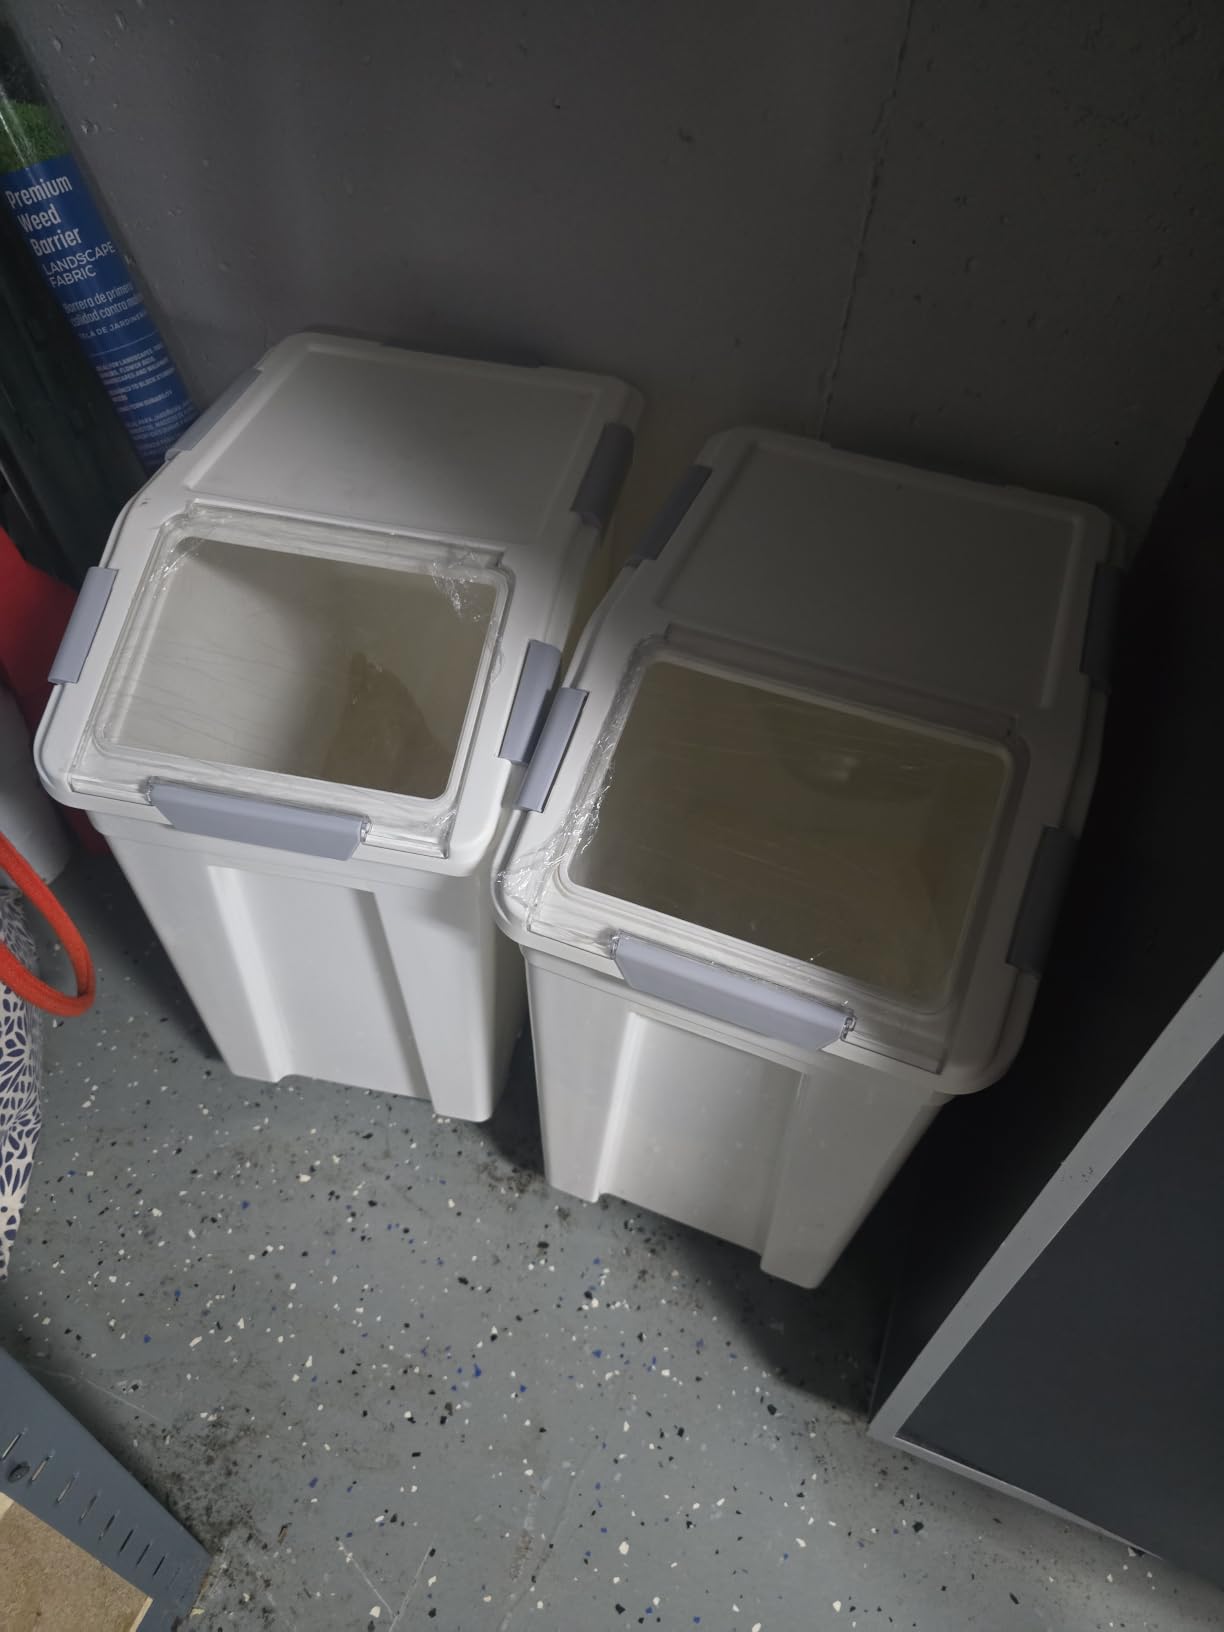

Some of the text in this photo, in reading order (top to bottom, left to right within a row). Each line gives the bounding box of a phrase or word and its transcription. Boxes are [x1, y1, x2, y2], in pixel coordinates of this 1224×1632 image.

[5, 175, 73, 208] Premium
[17, 203, 62, 233] Weed
[30, 227, 82, 256] Barrier
[42, 241, 116, 275] LANDSCAPE
[49, 264, 97, 288] FABRIC
[94, 292, 107, 305] de
